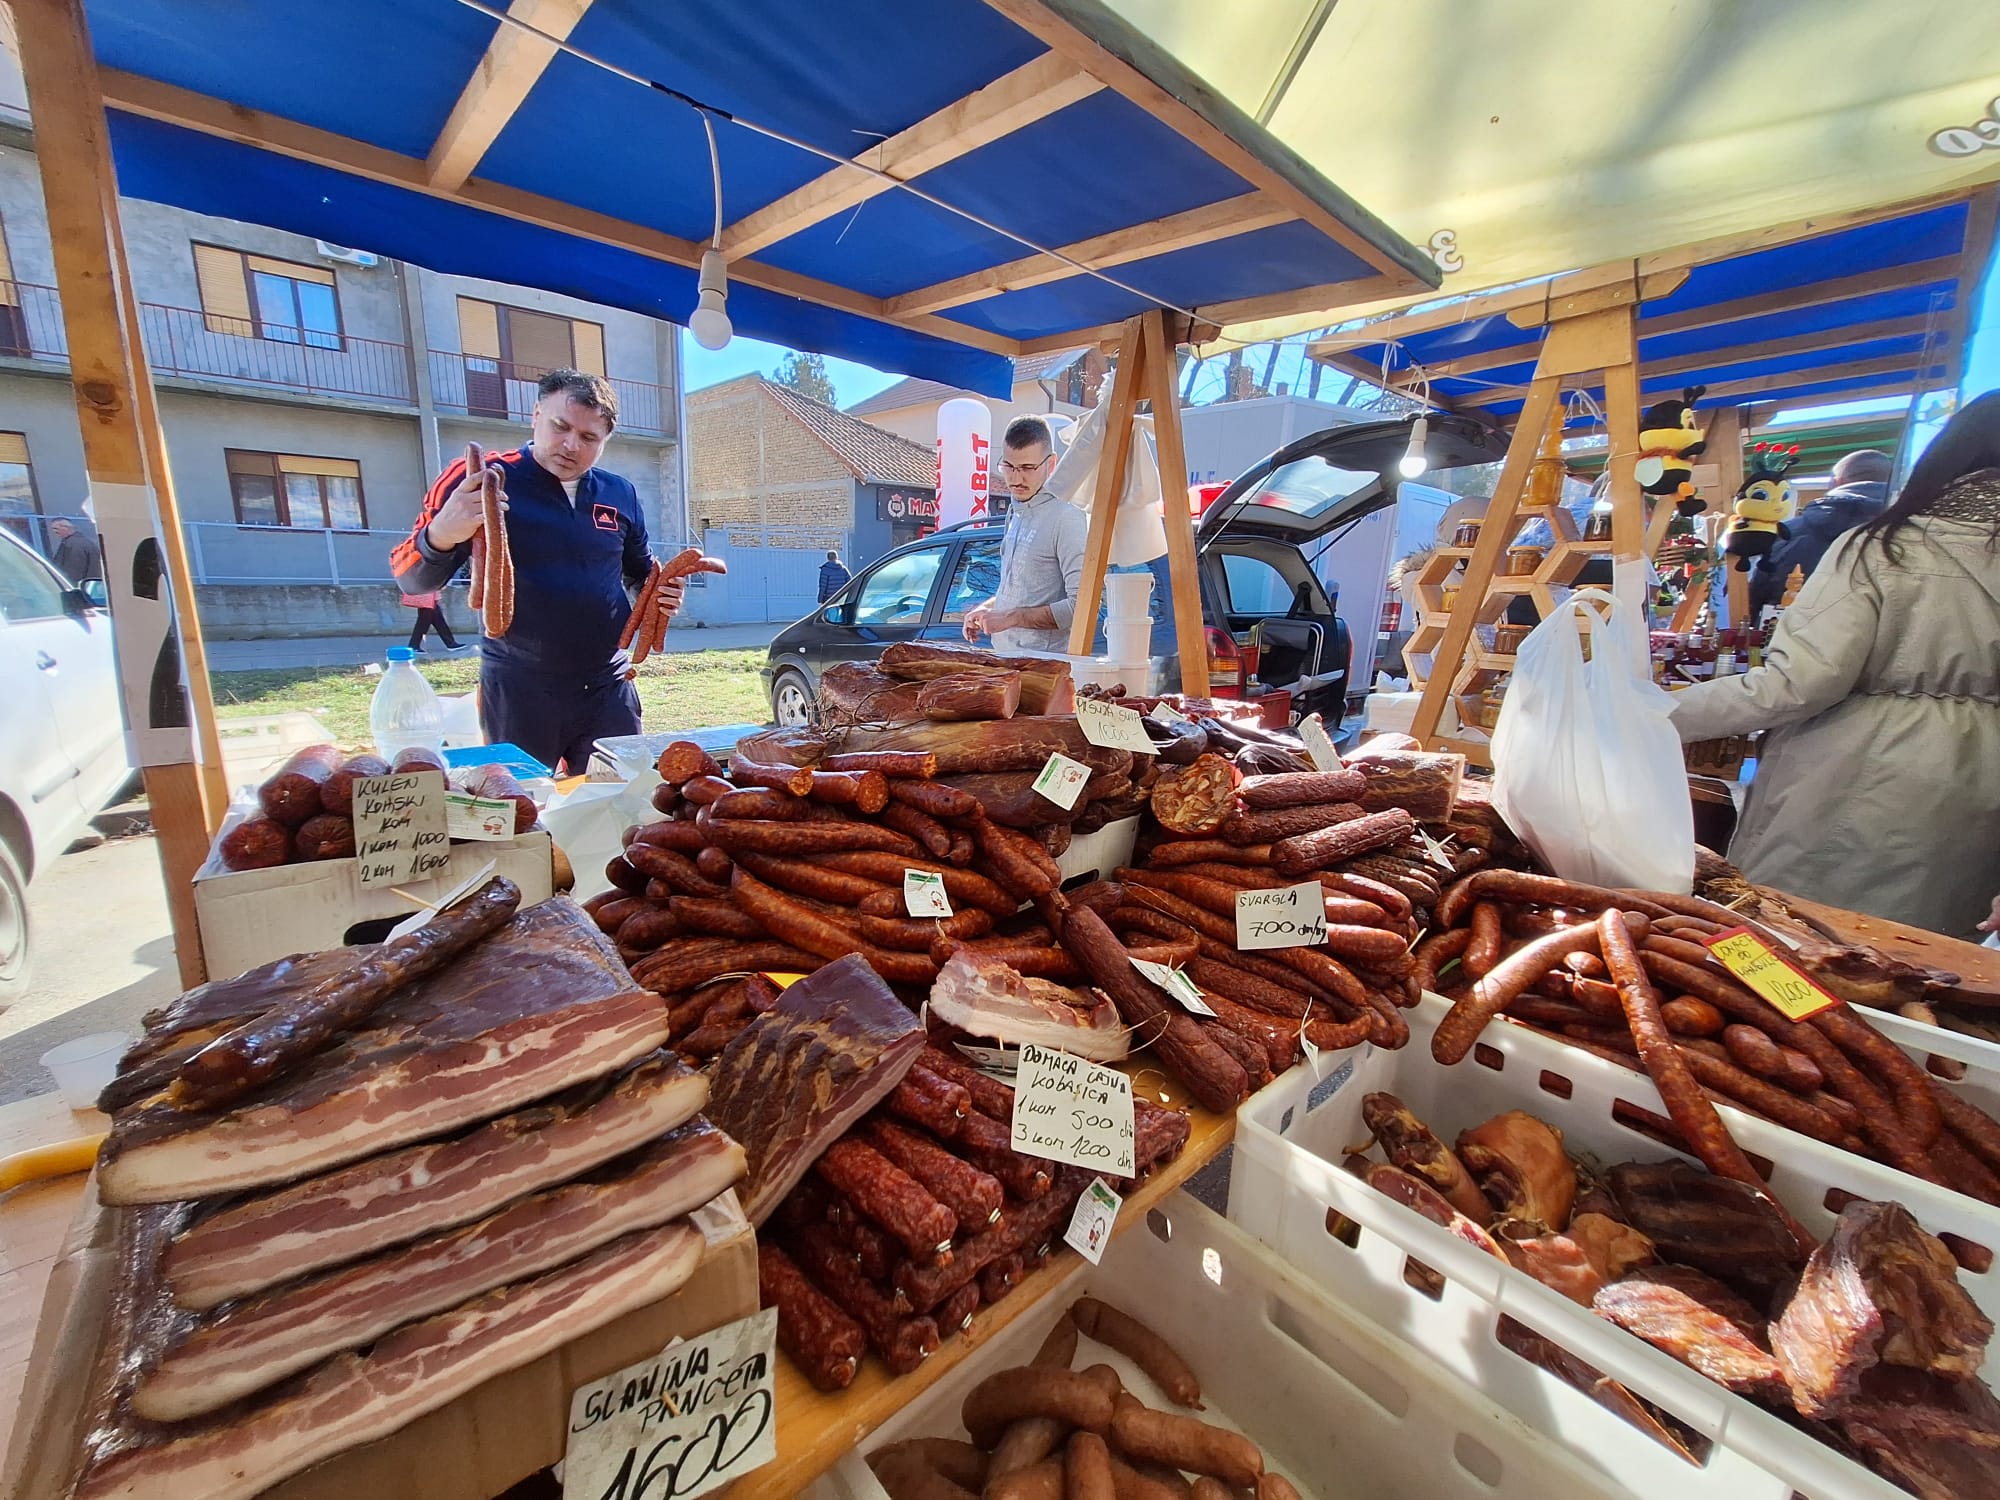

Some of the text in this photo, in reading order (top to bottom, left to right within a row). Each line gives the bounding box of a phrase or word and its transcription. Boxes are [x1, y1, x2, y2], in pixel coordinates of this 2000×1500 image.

[358, 777, 419, 798] KULEN
[412, 832, 446, 851] 1000
[361, 865, 370, 882] 2
[410, 853, 449, 874] 1600
[1239, 889, 1298, 908] SVARGLA
[1249, 920, 1296, 937] 700
[1017, 1095, 1028, 1114] 1
[1071, 1109, 1114, 1131] 500
[1014, 1123, 1028, 1141] 3
[1071, 1134, 1111, 1159] 1200
[572, 1346, 710, 1433] SLANINA
[600, 1388, 773, 1500] 1600
